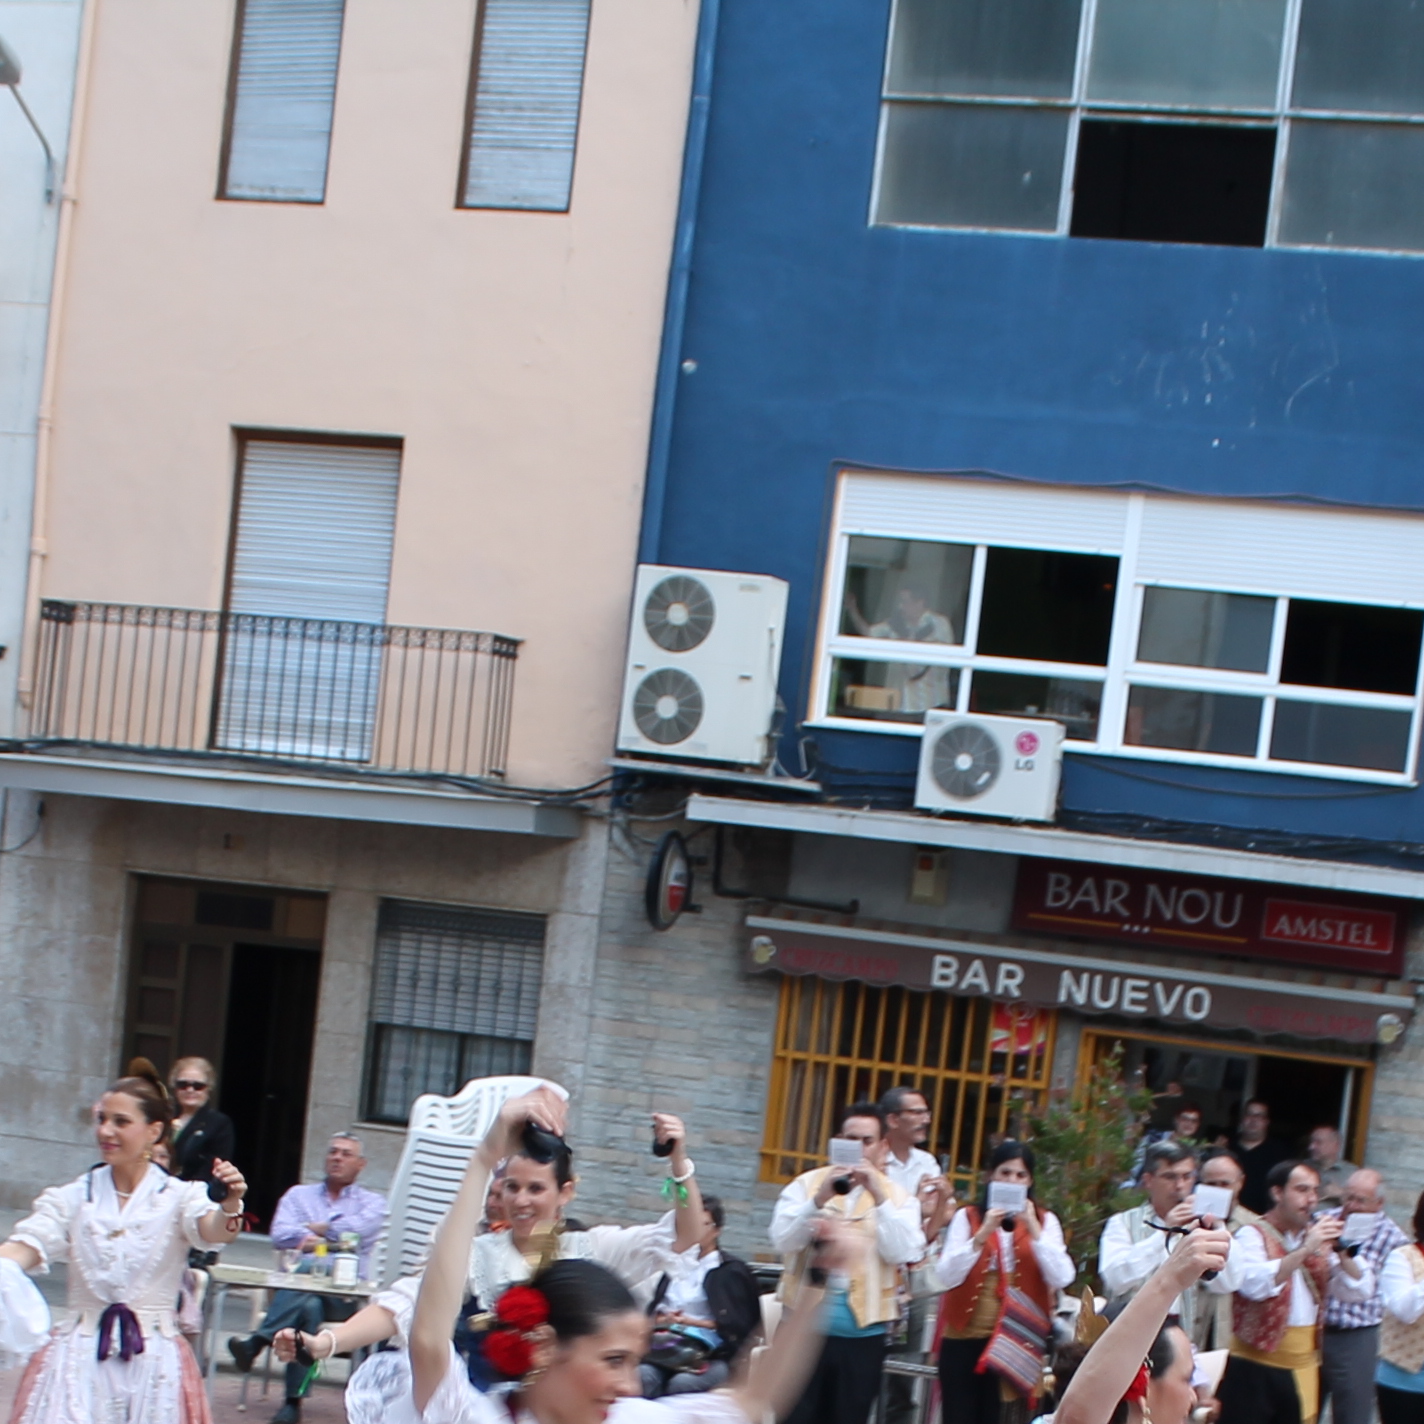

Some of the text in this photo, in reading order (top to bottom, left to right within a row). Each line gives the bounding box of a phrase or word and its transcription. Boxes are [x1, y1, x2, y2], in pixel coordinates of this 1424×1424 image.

[1015, 759, 1035, 772] LG
[1045, 874, 1244, 928] BAR NOU
[1272, 913, 1379, 946] AMSTEL
[931, 954, 1212, 1020] BAR NUEVO
